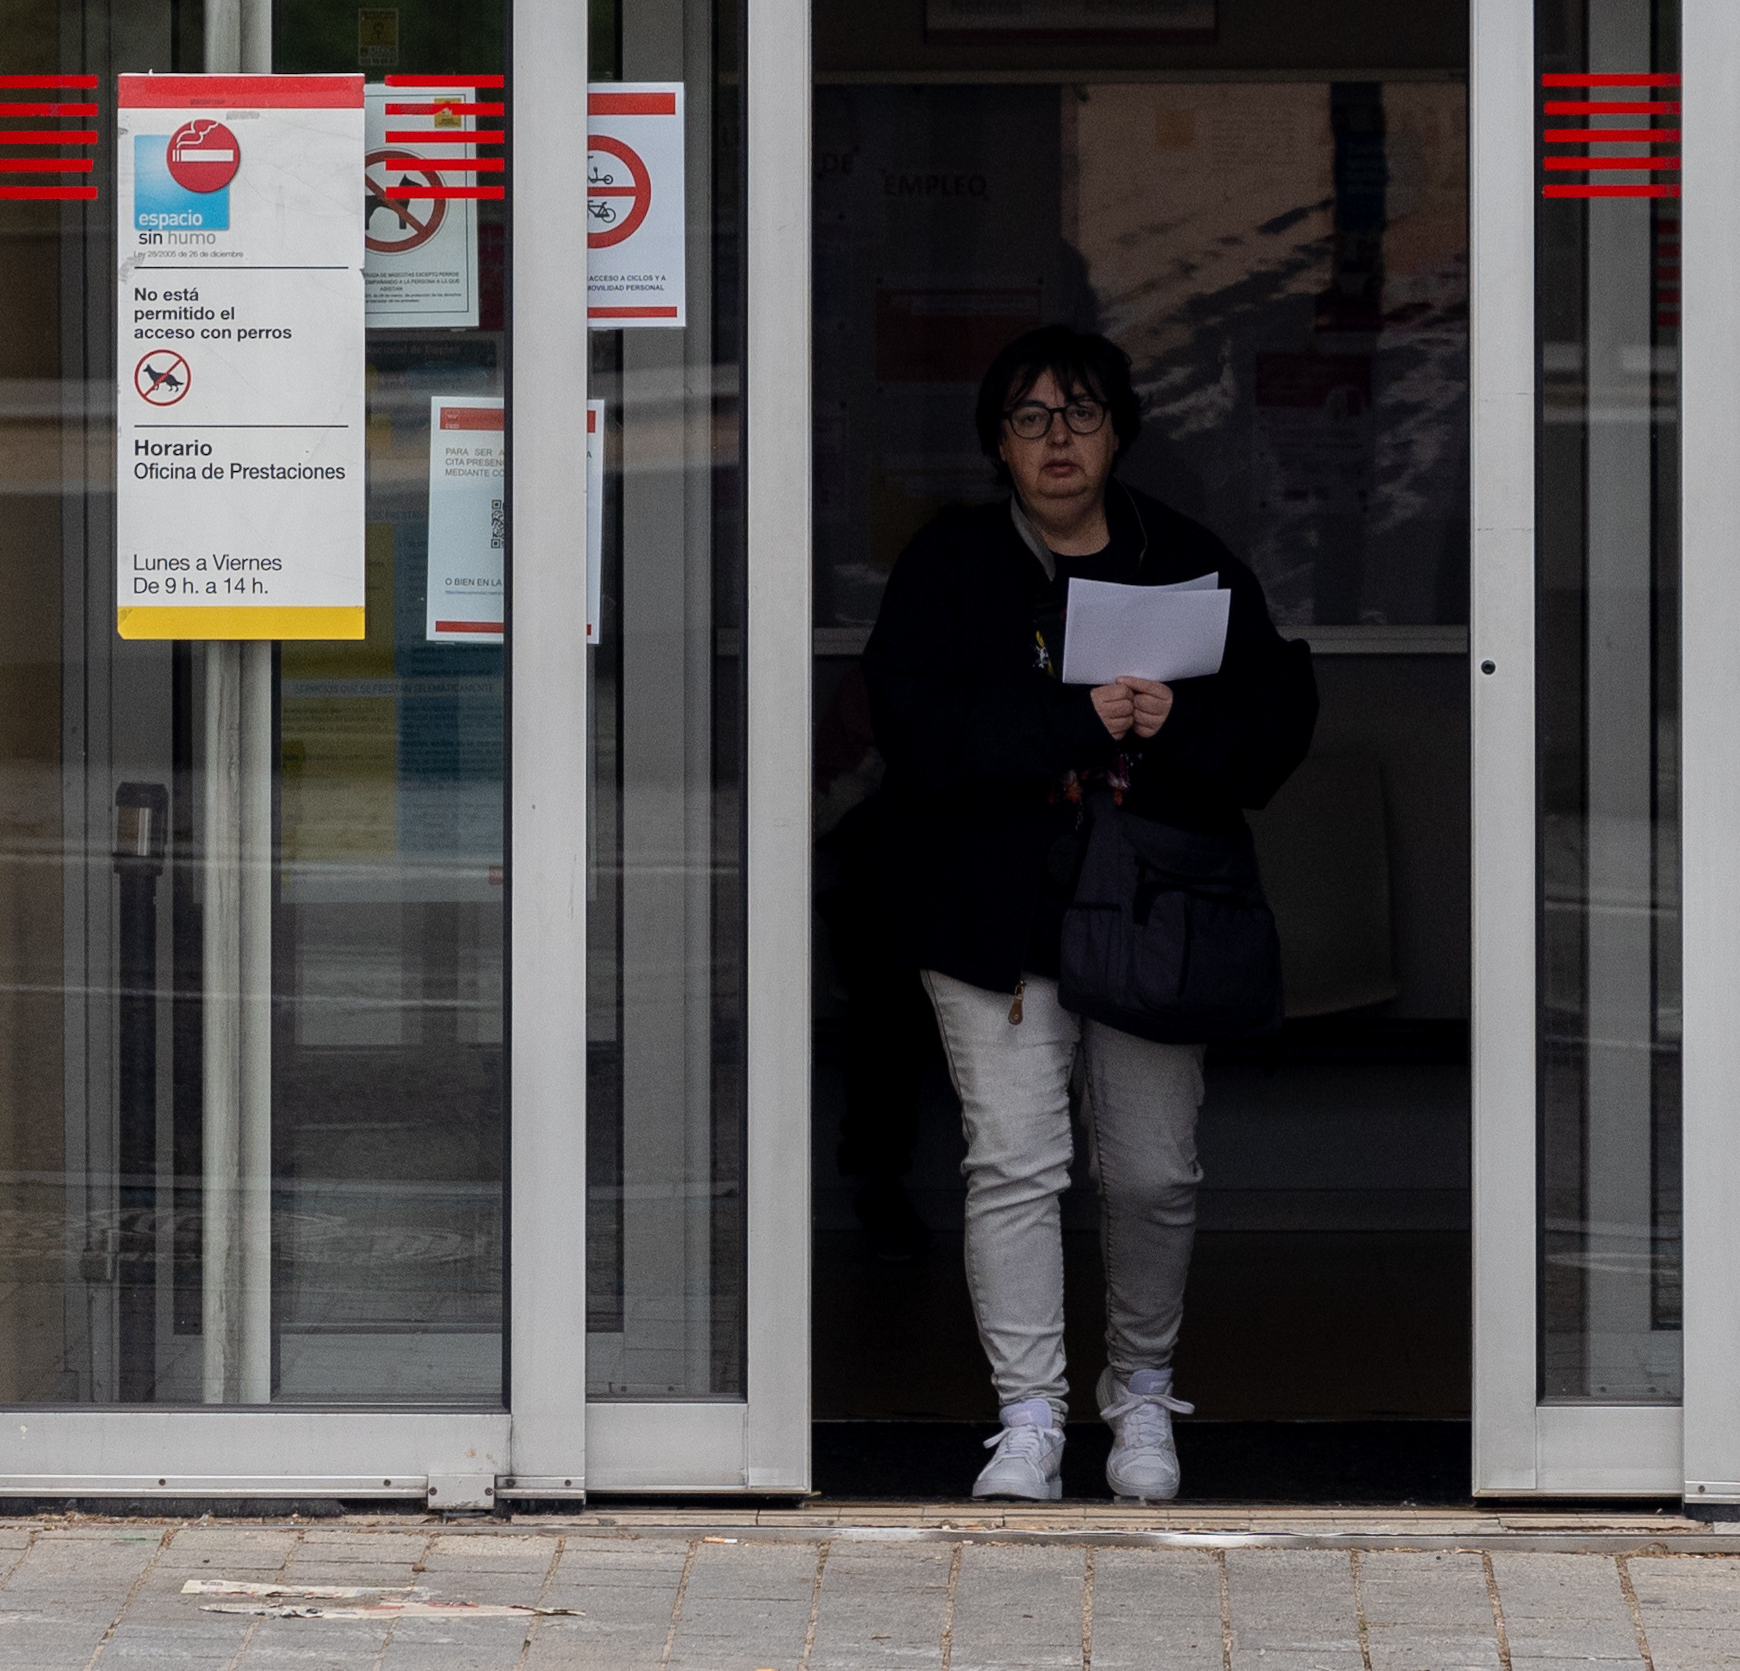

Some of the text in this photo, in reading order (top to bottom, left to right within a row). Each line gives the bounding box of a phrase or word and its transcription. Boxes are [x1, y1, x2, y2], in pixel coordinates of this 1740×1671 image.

[138, 210, 203, 230] espacio
[138, 229, 216, 245] sin humo
[134, 286, 199, 302] No está
[133, 306, 235, 324] permitido el
[133, 328, 293, 343] acceso con perros
[134, 439, 213, 457] Horario
[445, 448, 469, 456] PARA
[475, 448, 493, 457] SER
[133, 461, 346, 480] Oficina de Prestaciones
[445, 458, 504, 467] CITA PRESEN
[445, 469, 490, 477] MEDIANTE
[133, 553, 283, 572] Lunes a Viernes
[133, 576, 269, 595] De 9 h. a 14 h.
[445, 578, 502, 587] O BIEN EN LA
